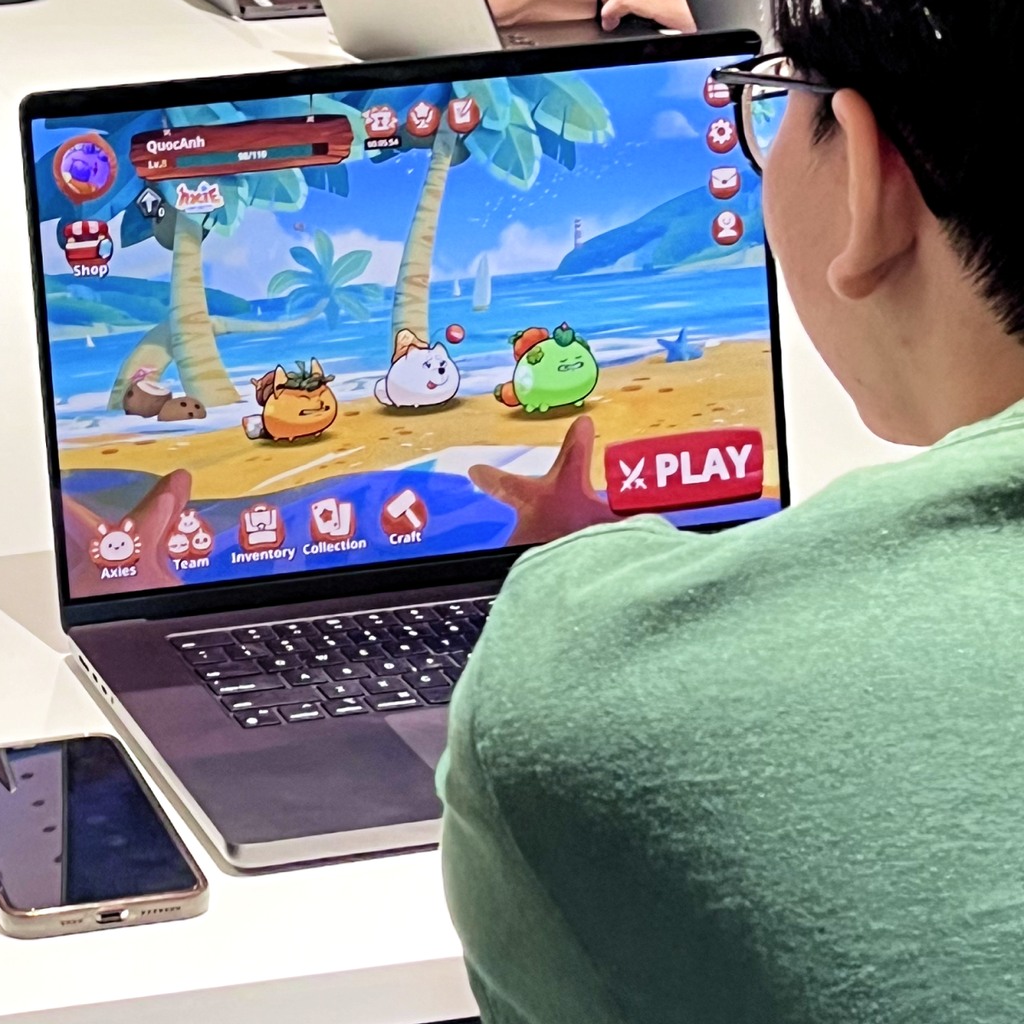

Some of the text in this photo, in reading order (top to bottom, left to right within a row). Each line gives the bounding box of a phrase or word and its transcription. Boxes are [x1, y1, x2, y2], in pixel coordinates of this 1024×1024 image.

[146, 136, 206, 155] QuocAnh
[73, 264, 108, 278] Shop
[656, 443, 753, 489] PLAY
[389, 531, 422, 545] Craft
[231, 546, 296, 563] Inventory
[302, 539, 367, 556] Collection
[173, 556, 210, 571] Team
[100, 565, 137, 579] Axies
